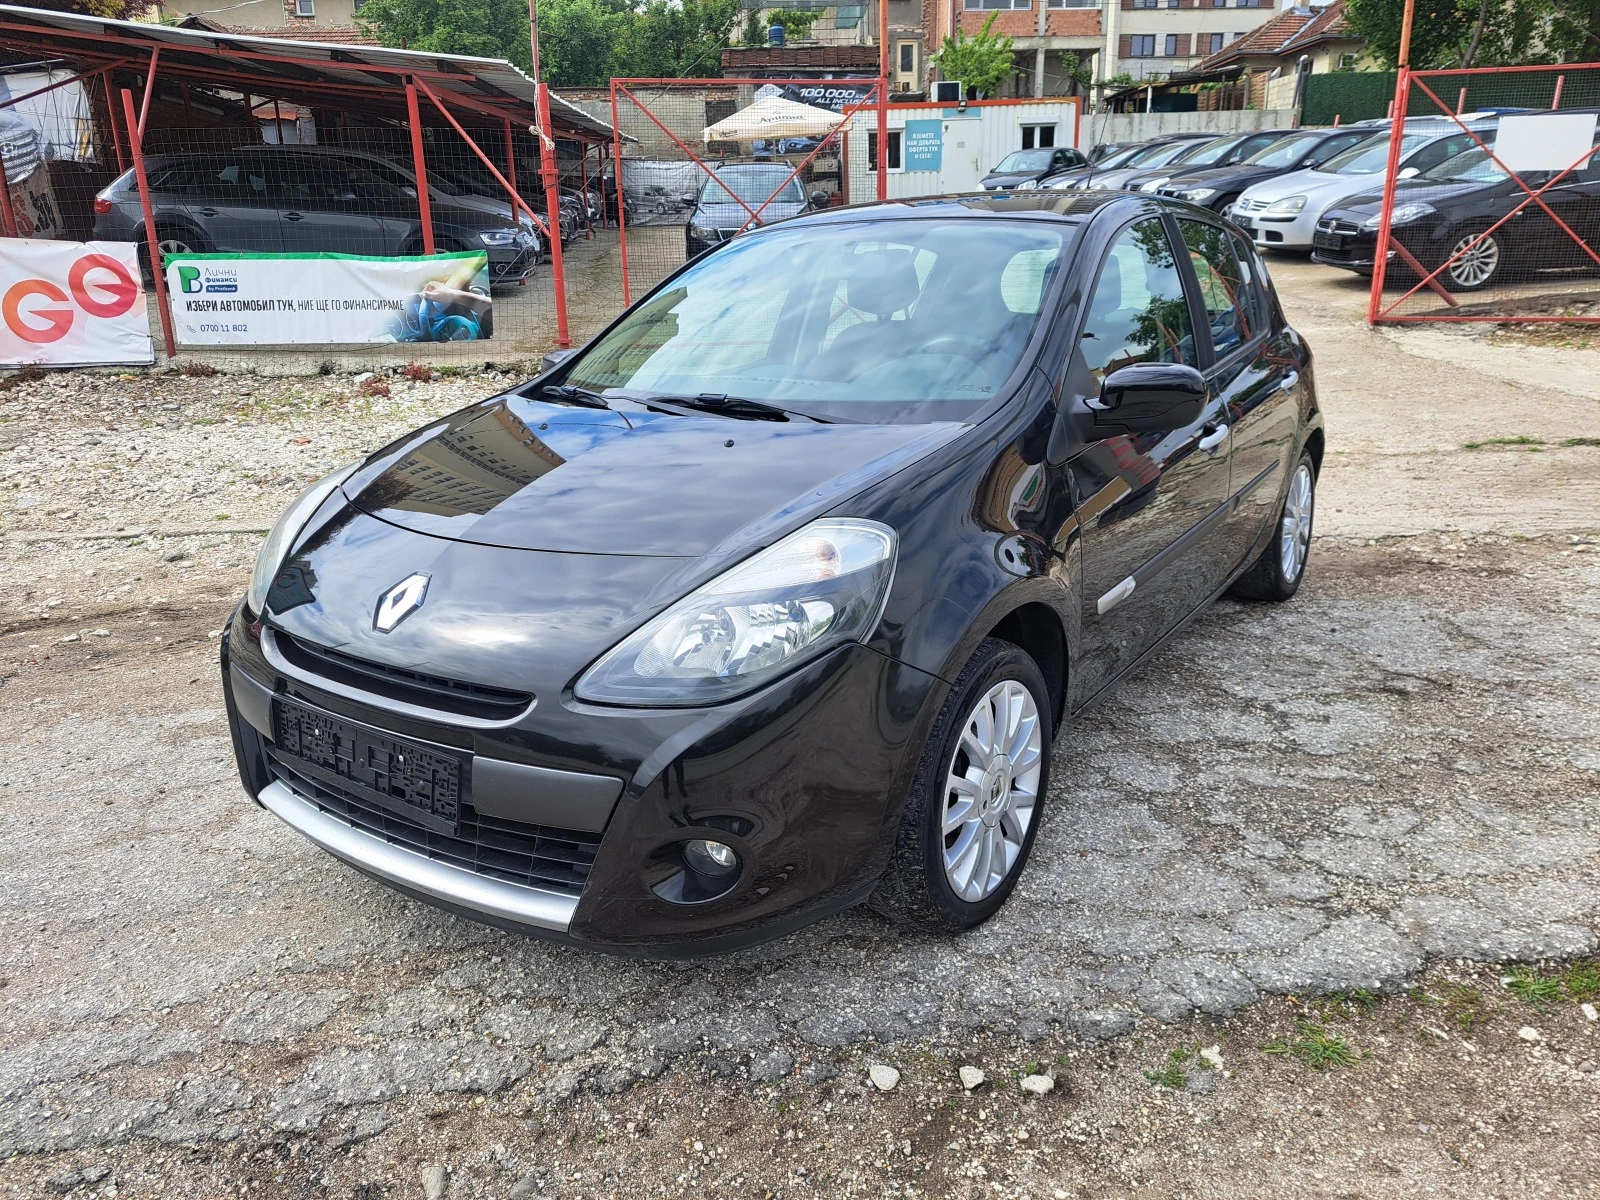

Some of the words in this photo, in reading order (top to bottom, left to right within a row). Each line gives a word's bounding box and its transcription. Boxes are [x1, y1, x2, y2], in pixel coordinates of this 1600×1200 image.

[799, 88, 825, 97] 100
[826, 89, 855, 98] 000
[204, 267, 237, 277] Лични
[186, 300, 218, 312] ИЗБЕРИ
[219, 300, 275, 312] АВТОМОБИЛ
[276, 300, 296, 312] ТУК,
[297, 299, 314, 311] НИЕ
[316, 299, 329, 312] ЩЕ
[331, 299, 341, 311] ГО
[342, 299, 405, 311] ФИНАНСИРАМЕ
[200, 324, 219, 332] 0700
[221, 324, 229, 332] 11
[232, 324, 248, 332] 802
